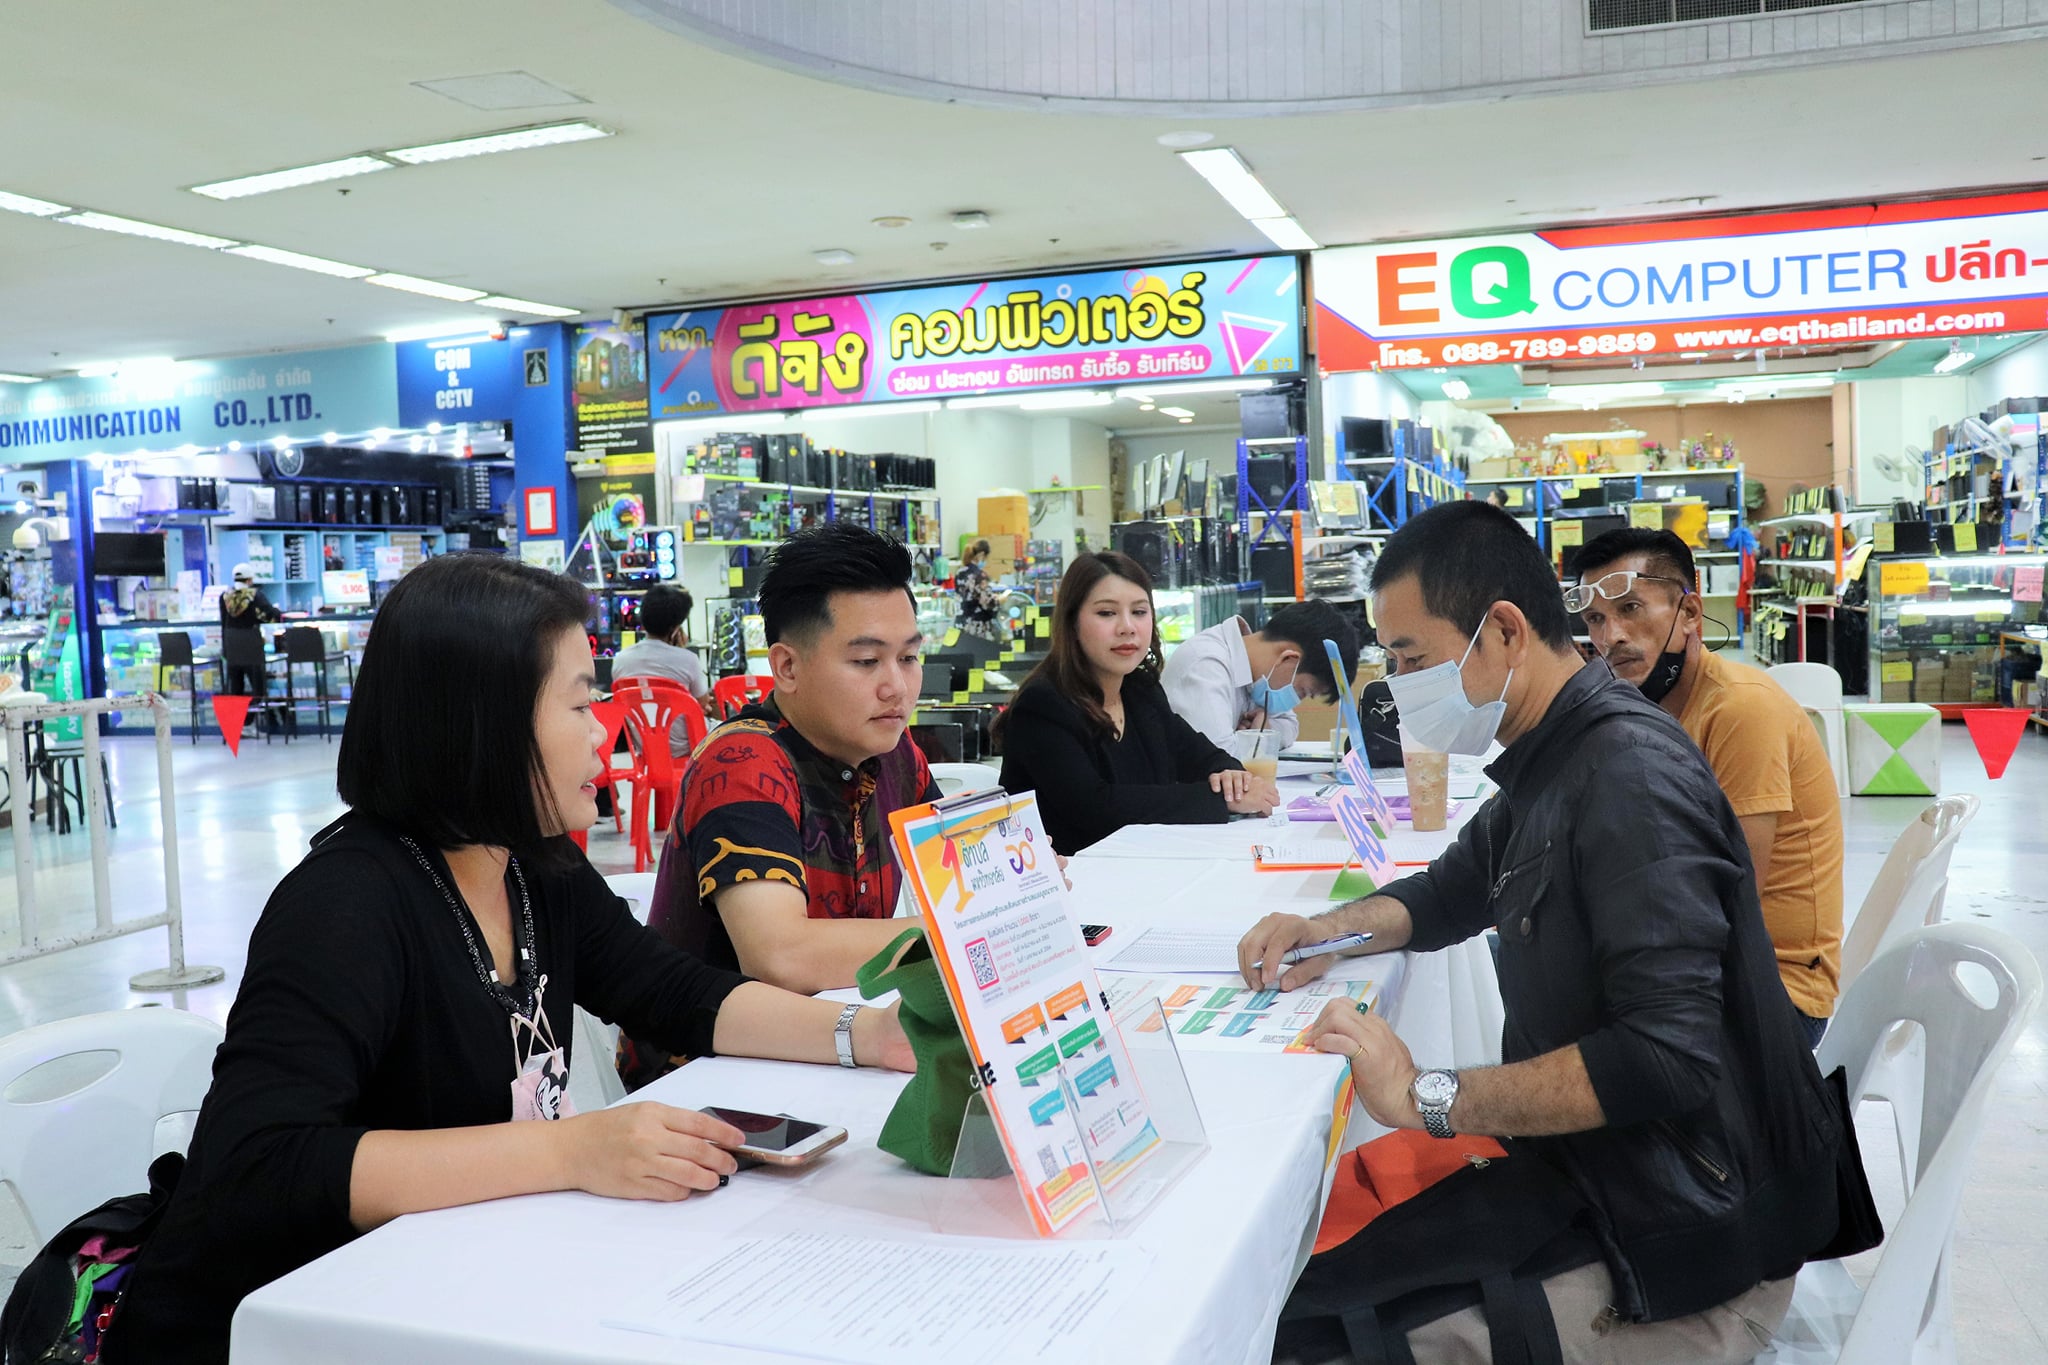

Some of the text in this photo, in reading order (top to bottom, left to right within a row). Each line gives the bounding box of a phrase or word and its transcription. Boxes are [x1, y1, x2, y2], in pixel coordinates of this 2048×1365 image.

[1376, 246, 1908, 326] EQ COMPUTER
[434, 347, 472, 372] COM
[731, 311, 868, 398] ดีจัง
[890, 271, 1206, 360] คอมพิวเตอร์
[1441, 332, 1656, 364] 088-789-9859
[1673, 311, 2006, 349] www.eqthailand.com
[447, 370, 460, 387] &
[892, 350, 1206, 394] ซ่อม ประกอบ อัพเกรด รับซื้อ รับเทิร์น
[213, 392, 323, 429] CO.,LTD.
[435, 388, 474, 410] CCTV
[1348, 757, 1387, 819] 49
[1336, 794, 1386, 872] 48
[941, 837, 990, 914] 1 ตำบล
